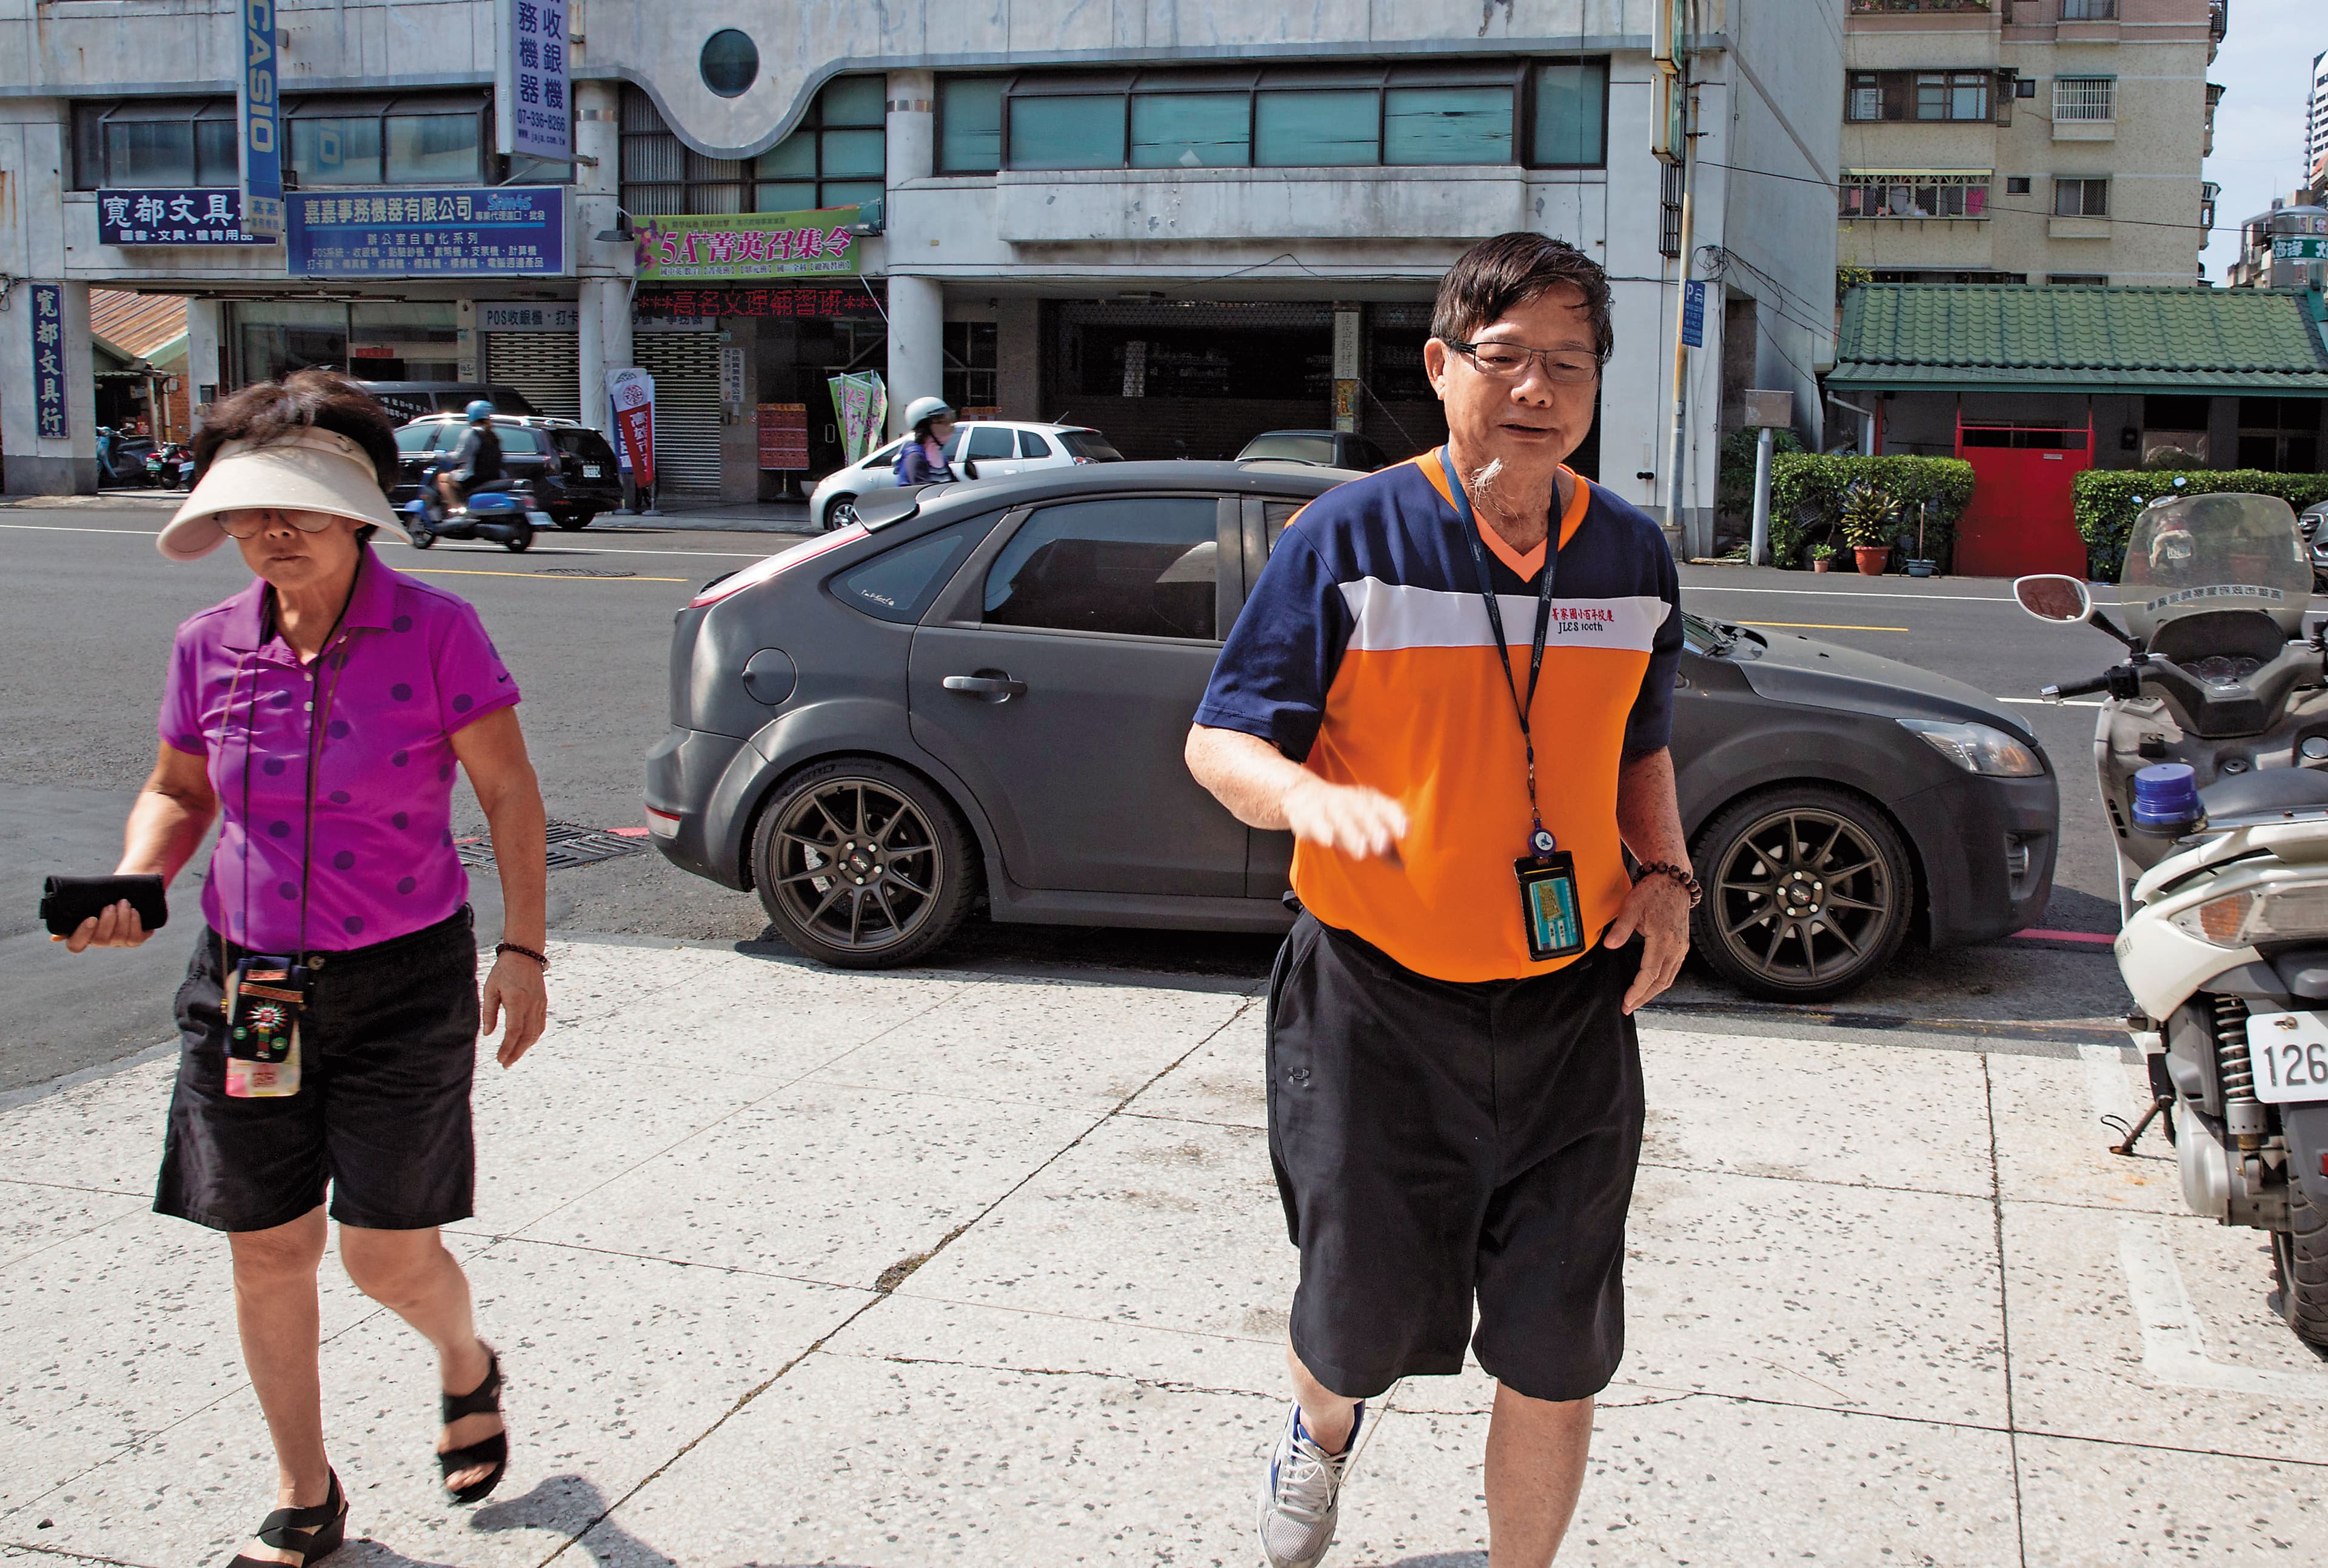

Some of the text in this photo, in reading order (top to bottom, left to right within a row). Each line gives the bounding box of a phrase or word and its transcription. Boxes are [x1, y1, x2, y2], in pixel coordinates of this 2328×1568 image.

[543, 0, 563, 110] 收銀機
[248, 0, 274, 153] CASIO
[518, 108, 566, 132] 07-336-8266
[103, 195, 241, 227] 寬都文具
[304, 196, 472, 224] 嘉嘉事務機器有限公司
[367, 232, 478, 245] 辦公室自動化系列
[1686, 283, 1693, 301] P
